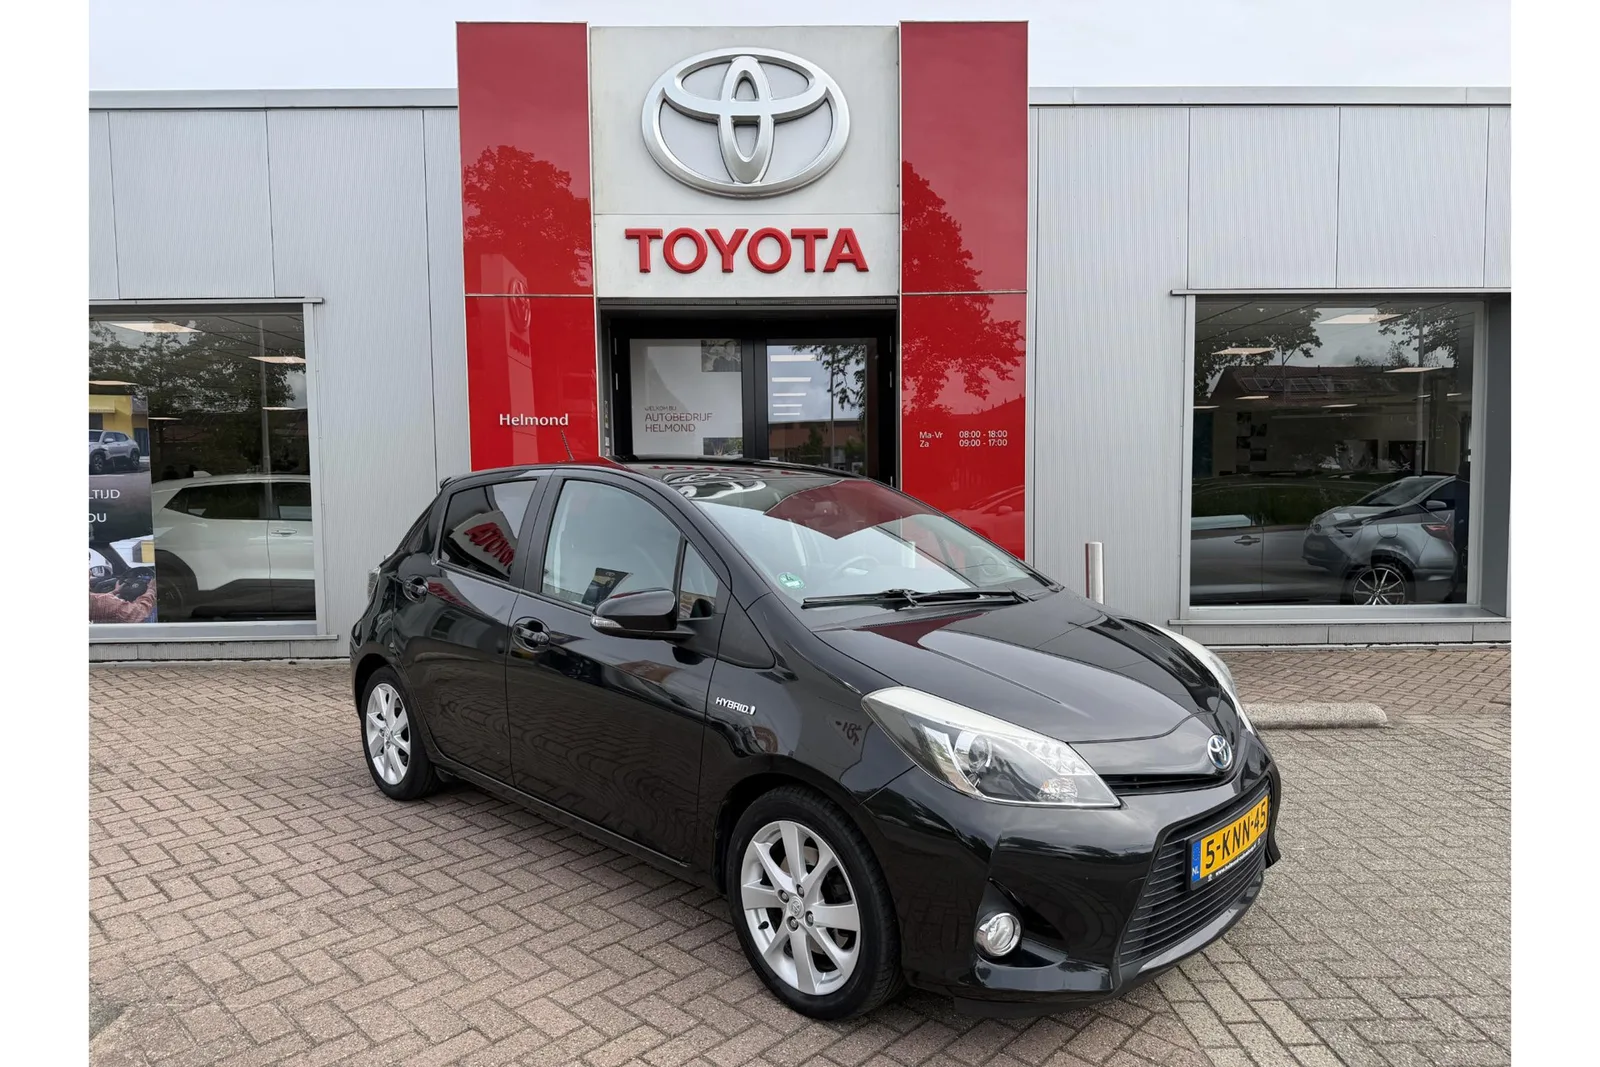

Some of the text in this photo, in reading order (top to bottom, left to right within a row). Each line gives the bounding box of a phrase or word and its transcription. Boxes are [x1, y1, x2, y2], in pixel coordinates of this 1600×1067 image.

[625, 227, 869, 274] TOYOTA
[499, 413, 569, 426] Helmond
[644, 412, 713, 422] AUTOBEDRIJF
[645, 423, 696, 432] HELMOND
[919, 431, 943, 439] Ma-Vr
[959, 430, 981, 438] 08:00
[988, 430, 1008, 438] 18:00
[919, 440, 930, 448] Za
[959, 439, 981, 447] 09:00
[988, 439, 1008, 447] 17:00
[715, 696, 750, 714] HYBRID
[1205, 801, 1266, 869] 5-KNN-45
